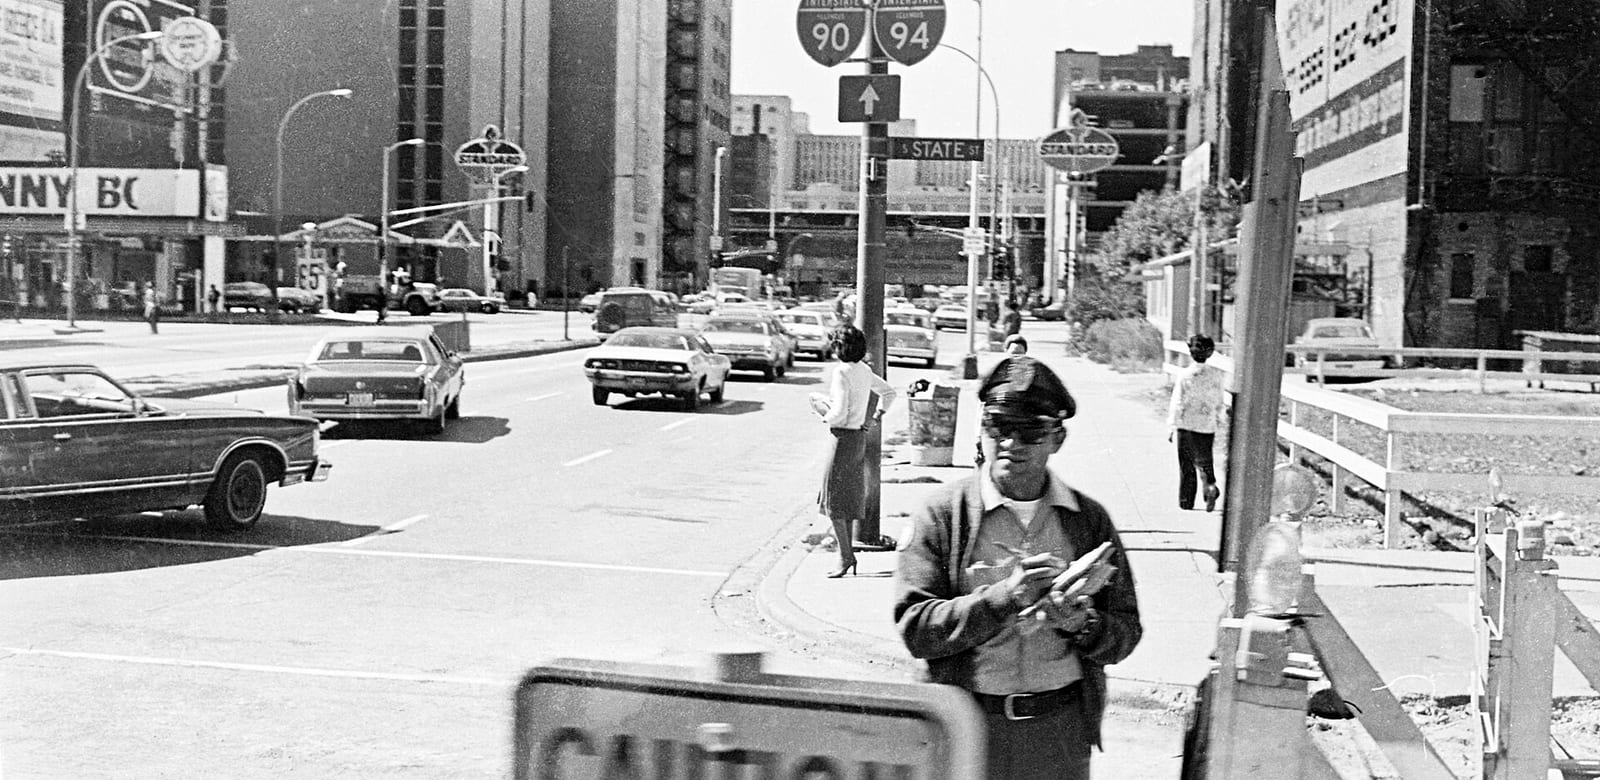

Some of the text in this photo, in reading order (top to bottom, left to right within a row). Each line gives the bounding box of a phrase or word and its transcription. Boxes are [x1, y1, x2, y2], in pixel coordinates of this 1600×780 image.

[812, 22, 850, 51] 90
[890, 21, 930, 50] 94
[902, 141, 980, 158] S STATE ST
[1040, 144, 1117, 156] STANDARD
[459, 154, 522, 165] STANDARD
